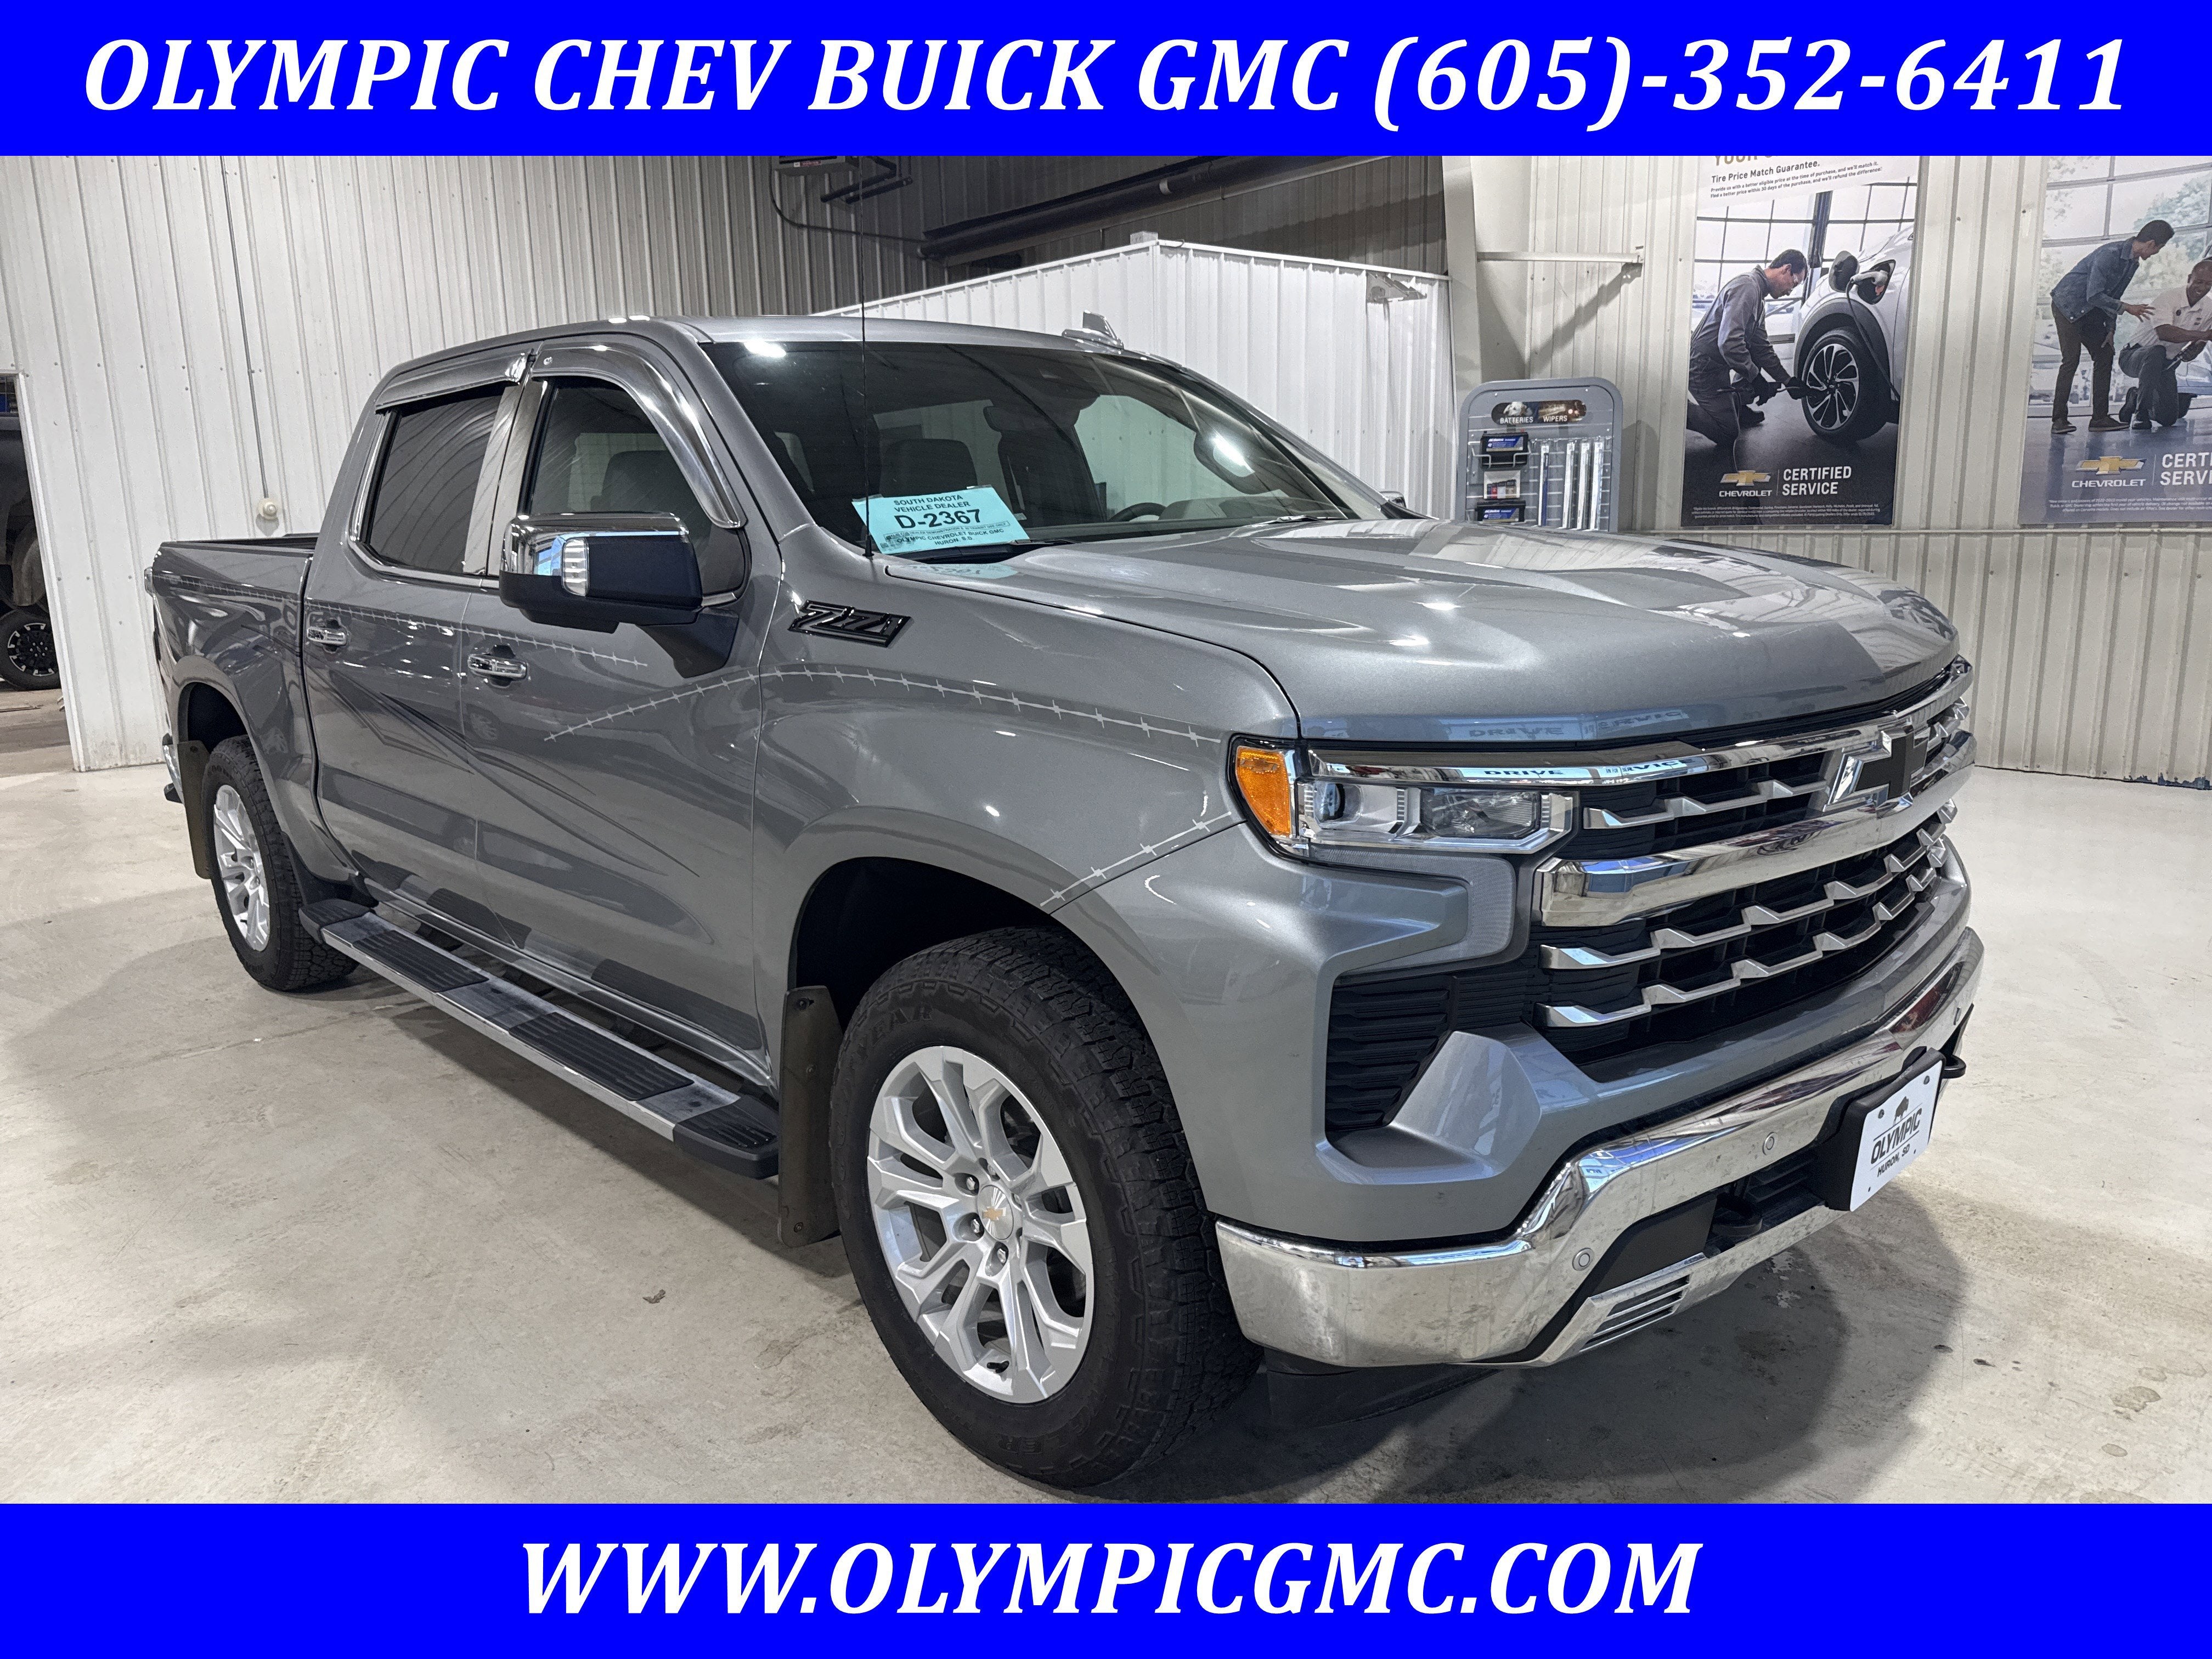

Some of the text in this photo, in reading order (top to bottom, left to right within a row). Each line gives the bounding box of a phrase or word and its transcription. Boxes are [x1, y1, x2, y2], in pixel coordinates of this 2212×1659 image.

[1712, 161, 1820, 183] Tire Price Match Guarantee.
[1783, 466, 1852, 481] CERTIFIED
[1782, 482, 1838, 496] SERVICE
[2072, 479, 2146, 488] CHEVROLET
[894, 504, 933, 512] VEHICLE
[894, 509, 981, 528] D-2367
[927, 531, 966, 540] CHEVROLET
[787, 600, 912, 648] Z71
[1871, 1108, 1922, 1164] OLYMPIC
[1877, 1143, 1910, 1177] HURON, SD
